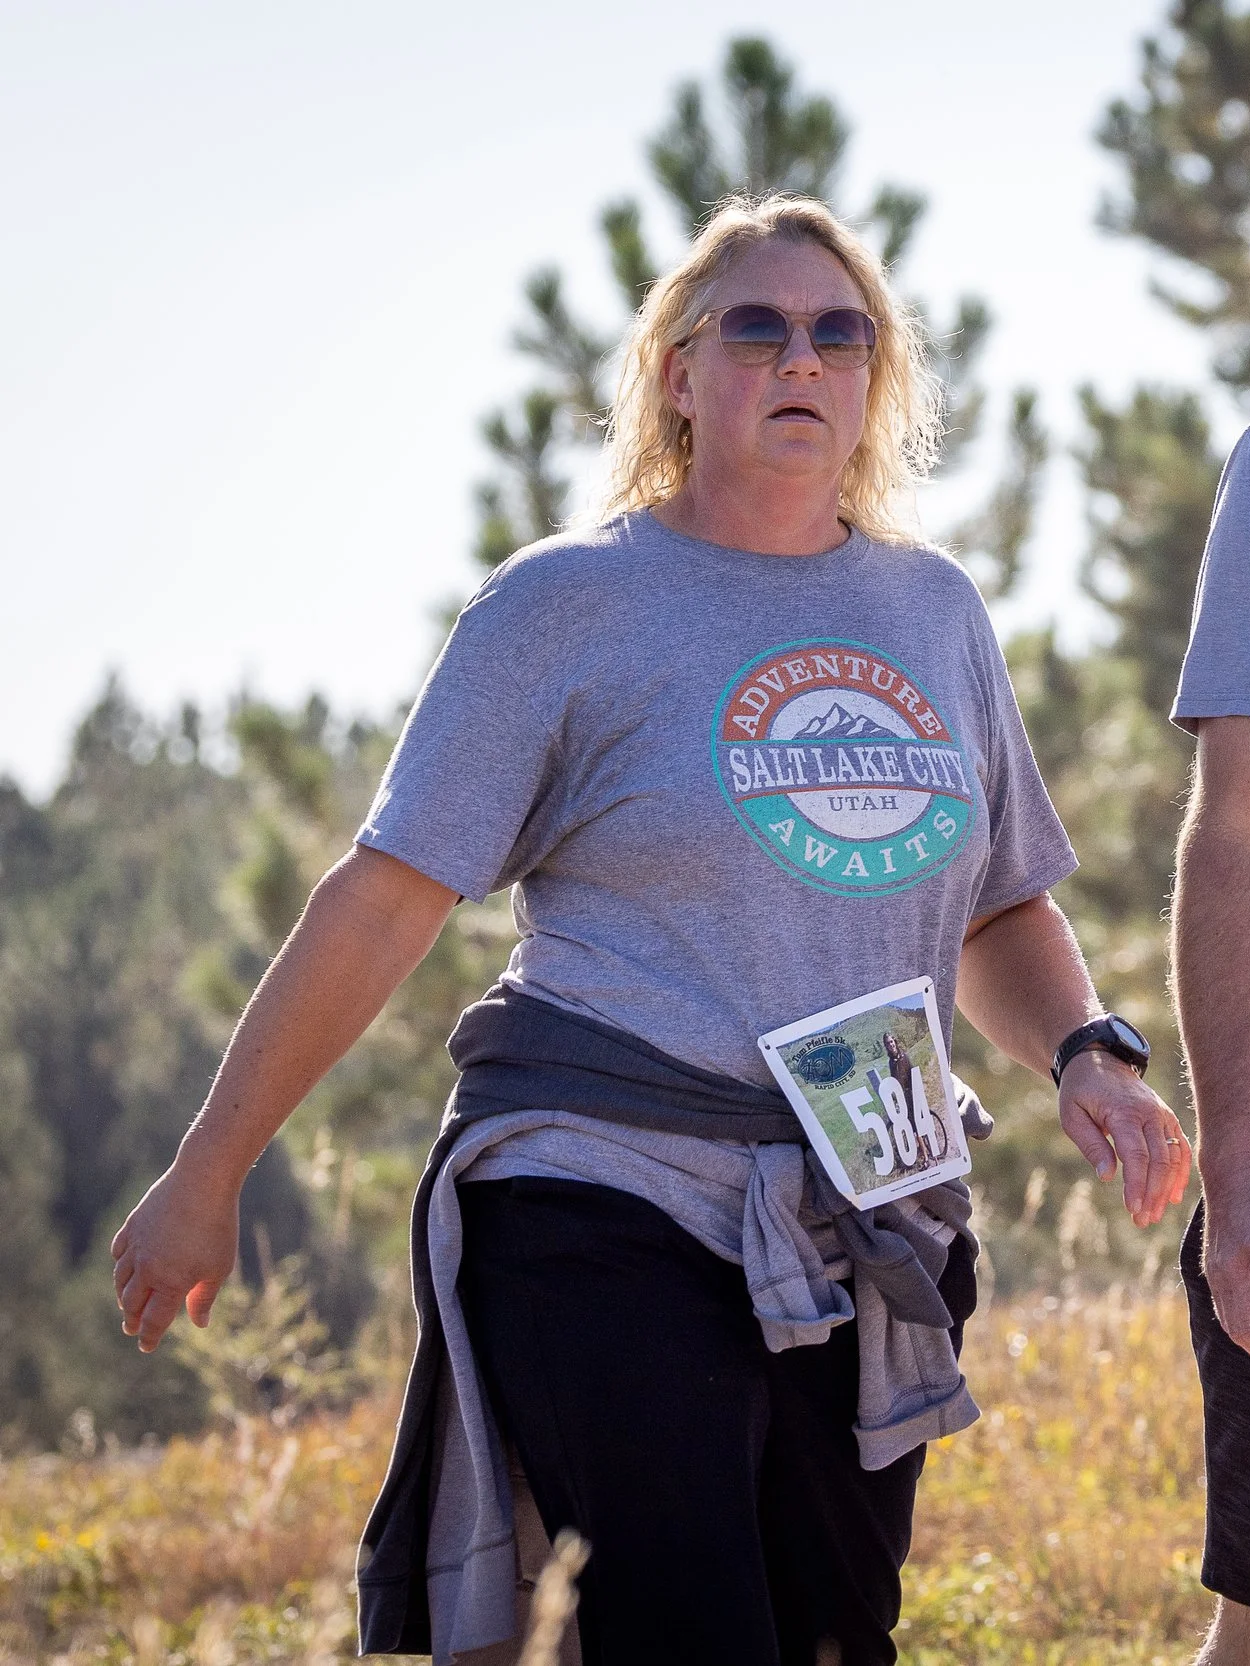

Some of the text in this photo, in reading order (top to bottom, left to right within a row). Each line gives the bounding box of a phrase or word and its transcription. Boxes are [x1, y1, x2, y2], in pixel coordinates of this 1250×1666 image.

[732, 654, 942, 738] ADVENTURE
[729, 745, 971, 795] SALT LAKE CITY
[827, 795, 899, 812] UTAH
[769, 810, 957, 878] AWAITS
[792, 1047, 808, 1062] Tom
[840, 1065, 941, 1176] 584
